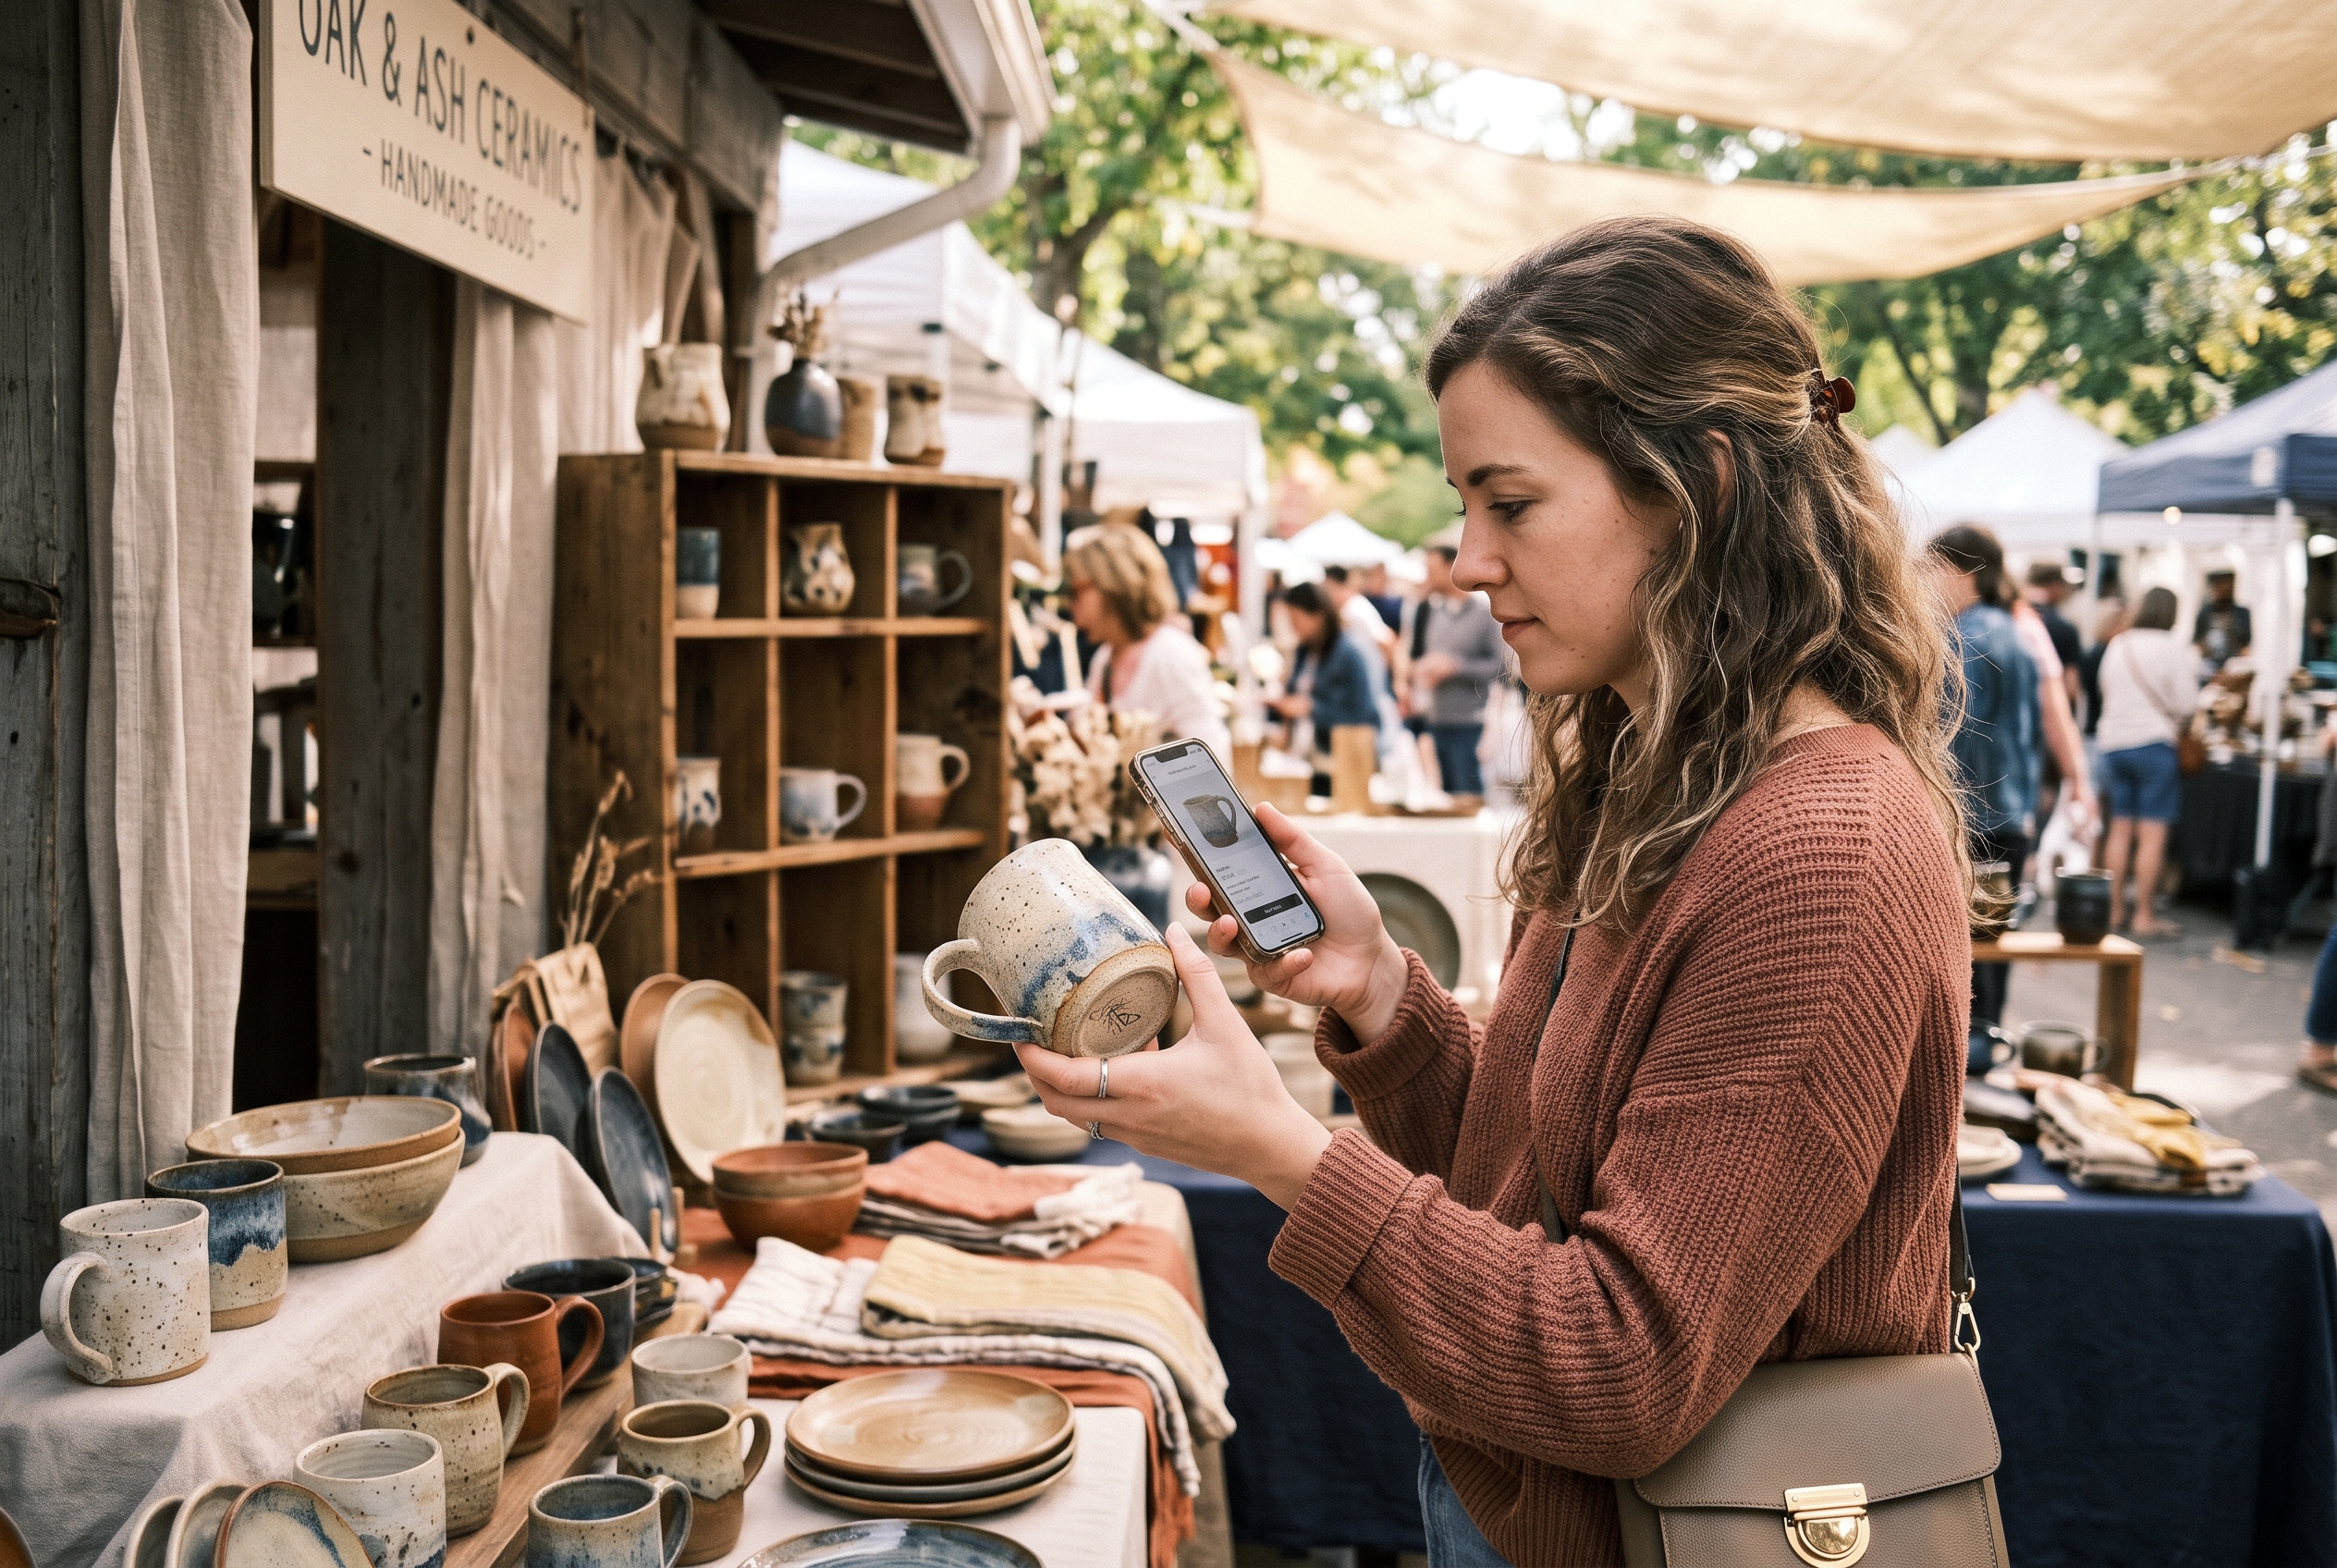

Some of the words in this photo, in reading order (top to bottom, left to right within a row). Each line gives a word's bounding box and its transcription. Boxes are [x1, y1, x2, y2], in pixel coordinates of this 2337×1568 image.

[382, 10, 402, 106] &
[415, 34, 466, 144] ASH
[476, 78, 582, 214] CERAMICS
[381, 138, 478, 234] HANDMADE
[483, 193, 535, 261] GOODS
